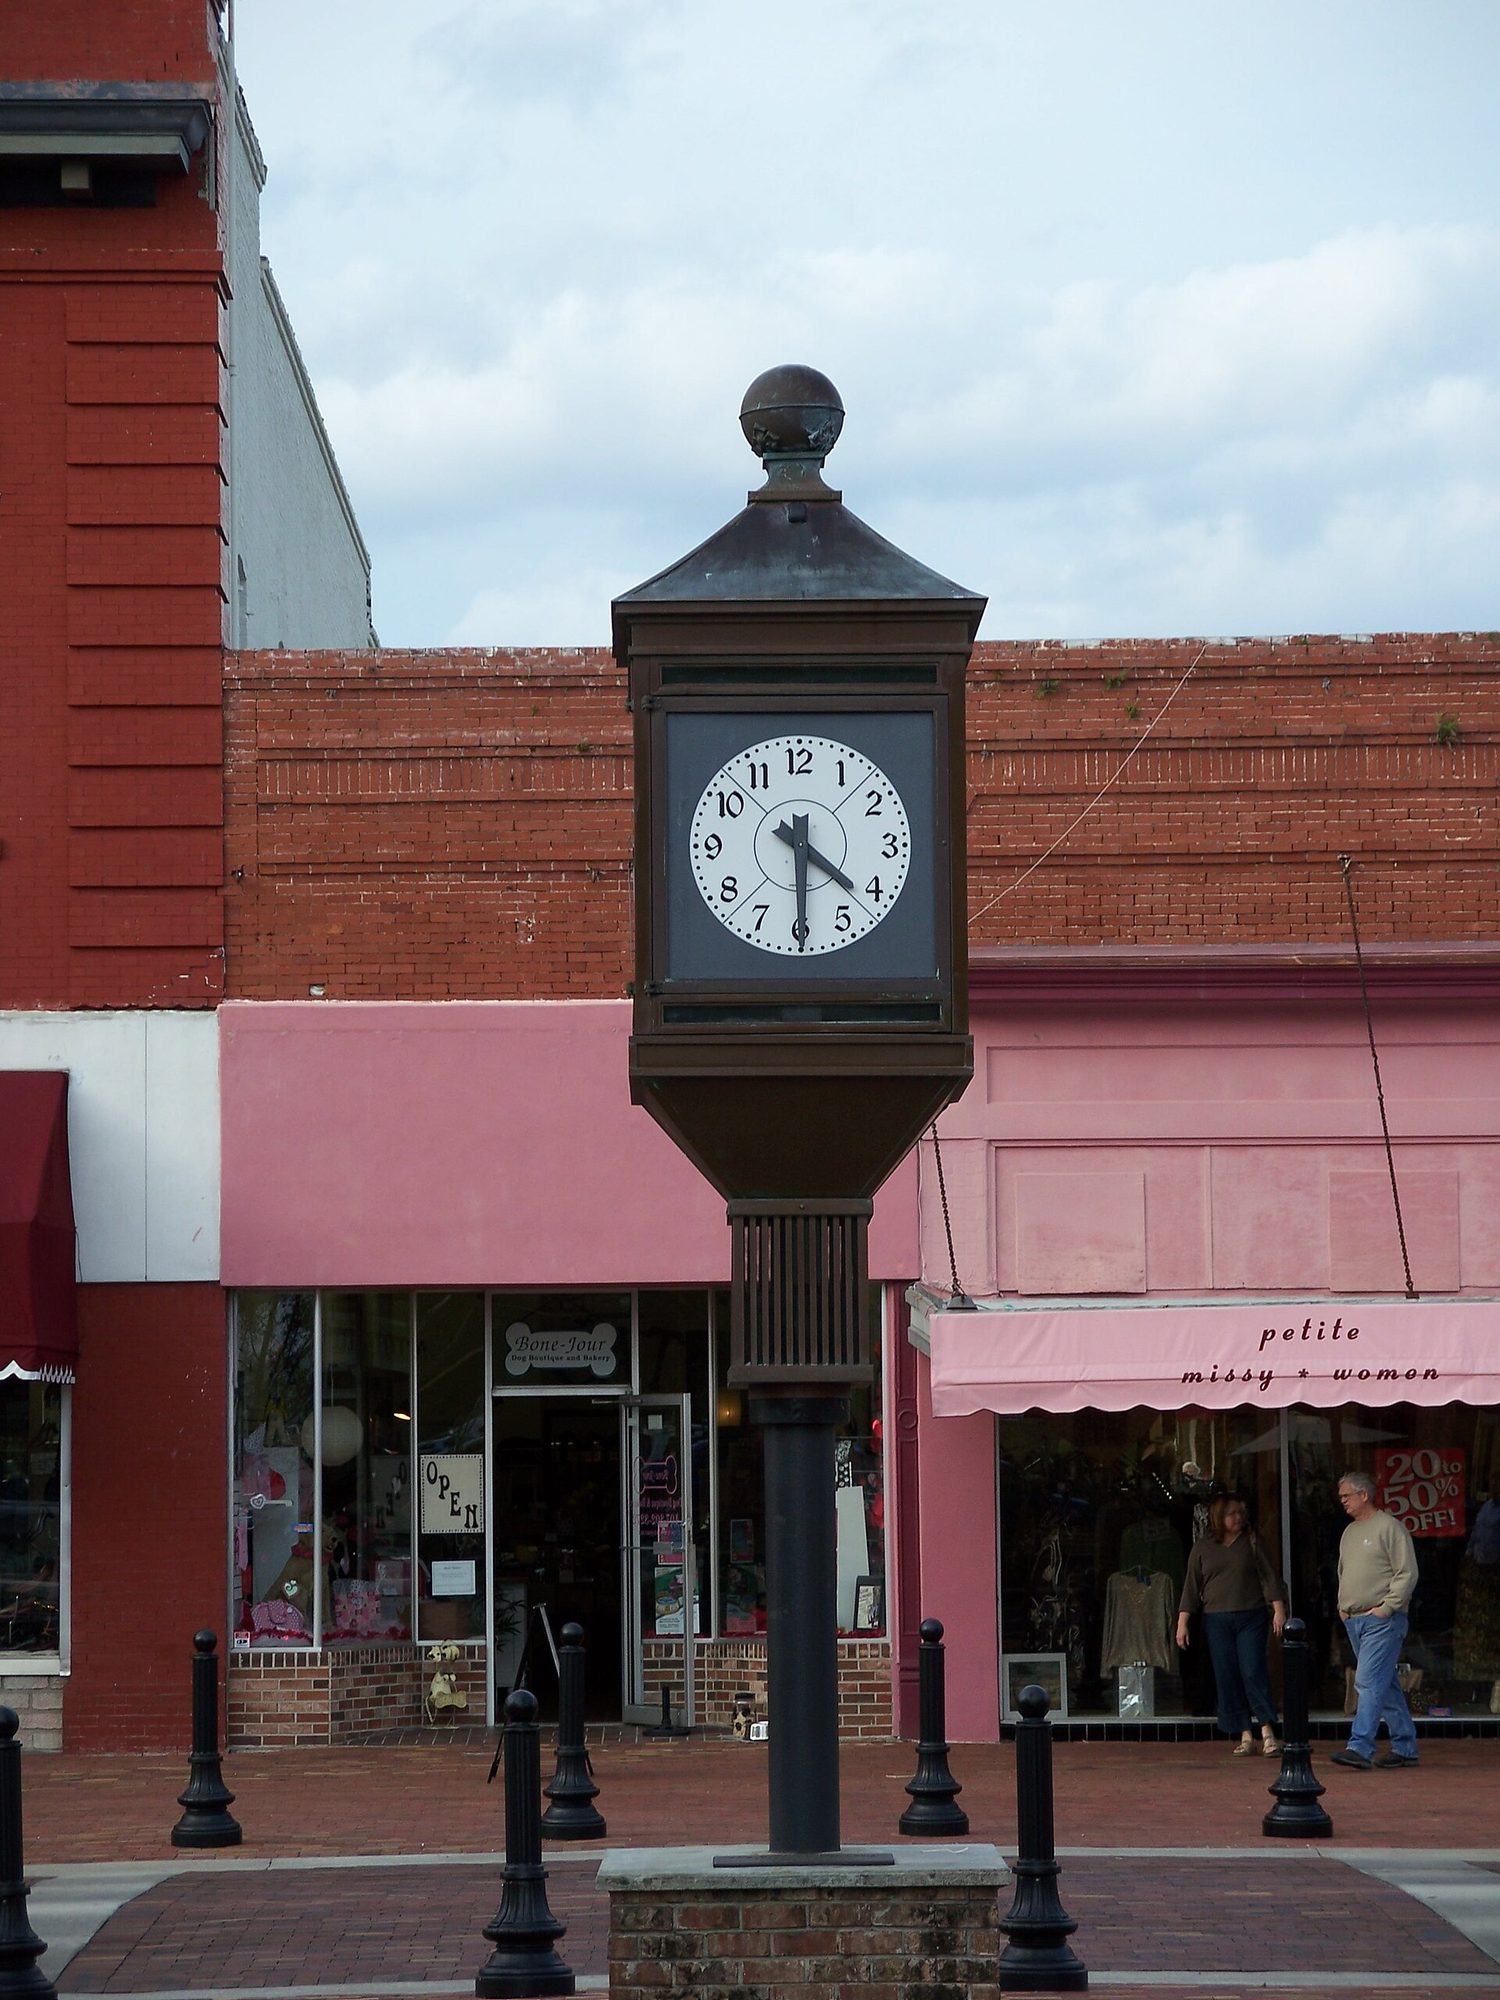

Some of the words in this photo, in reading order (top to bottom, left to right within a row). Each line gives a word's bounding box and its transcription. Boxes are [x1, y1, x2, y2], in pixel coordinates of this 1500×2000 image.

[785, 747, 813, 776] 12
[835, 760, 846, 787] 1
[747, 762, 770, 790] 11
[716, 790, 745, 818] 10
[865, 789, 883, 817] 2
[704, 833, 723, 861] 9
[881, 832, 899, 859] 3
[720, 876, 738, 903] 8
[865, 875, 884, 903] 4
[752, 904, 770, 932] 7
[834, 905, 851, 932] 5
[515, 1336, 607, 1354] Bone-Jour
[1258, 1317, 1360, 1351] petite
[1181, 1364, 1275, 1391] missy
[1333, 1367, 1440, 1381] women
[1386, 1449, 1441, 1485] 20
[1441, 1460, 1462, 1475] to
[426, 1460, 479, 1529] OPEN
[1383, 1476, 1459, 1516] 50%
[1402, 1507, 1457, 1533] OFF!
